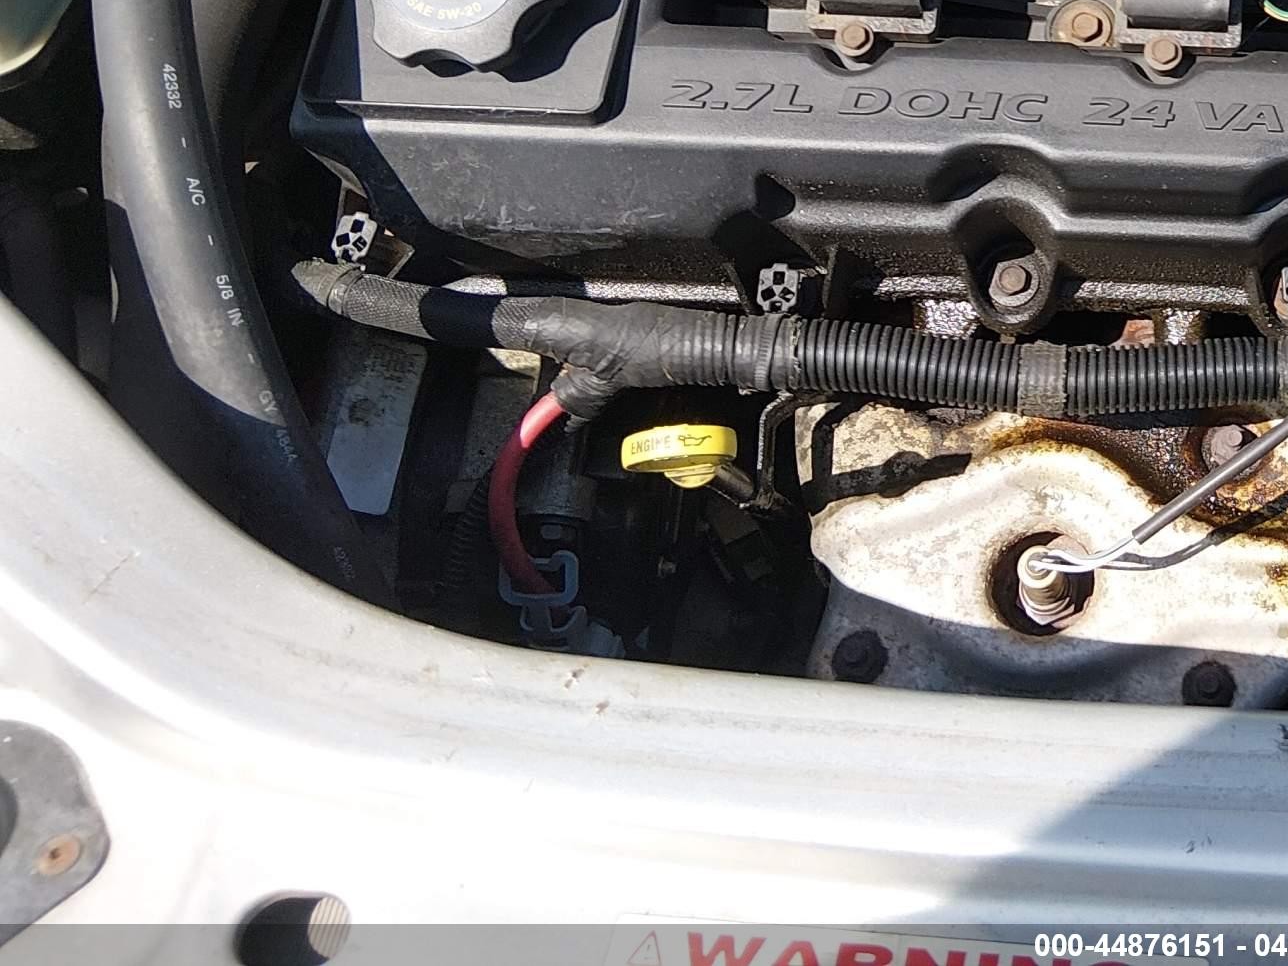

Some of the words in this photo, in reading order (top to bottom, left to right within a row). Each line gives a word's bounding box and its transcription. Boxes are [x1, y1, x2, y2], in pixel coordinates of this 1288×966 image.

[437, 2, 481, 20] 5W-20
[662, 79, 813, 114] 2.7L
[838, 86, 1049, 123] DOHC
[1083, 97, 1177, 129] 24
[163, 63, 182, 110] 42332
[186, 177, 206, 206] A/C
[216, 274, 234, 300] 5/8
[227, 308, 245, 327] IN
[258, 389, 279, 414] GY
[631, 435, 671, 455] ENGINE
